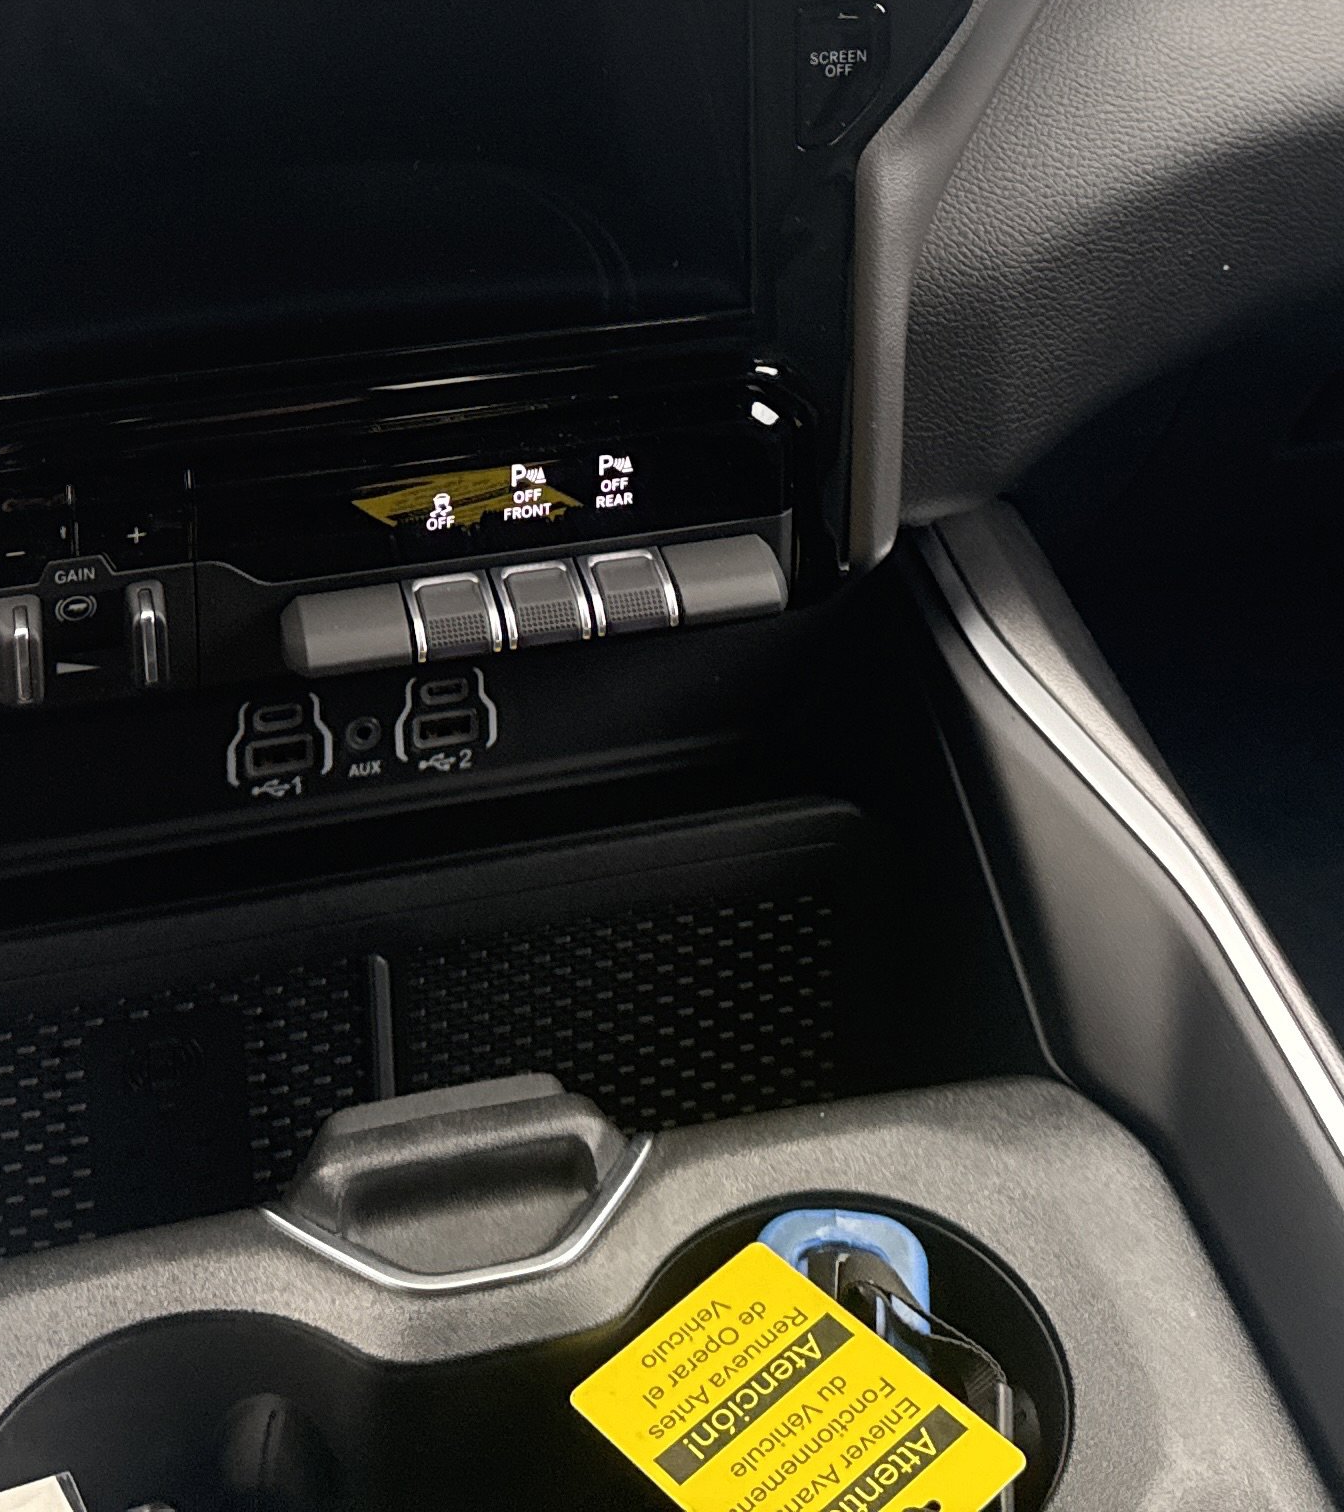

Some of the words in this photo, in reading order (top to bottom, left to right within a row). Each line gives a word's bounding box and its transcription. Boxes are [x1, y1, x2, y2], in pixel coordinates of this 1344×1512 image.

[809, 49, 867, 66] SCREEN
[825, 63, 854, 78] OFF
[600, 477, 629, 493] OFF
[513, 490, 542, 505] OFF
[596, 492, 633, 509] REAR
[426, 515, 455, 531] OFF
[504, 503, 552, 521] FRONT
[55, 567, 96, 585] GAIN
[348, 760, 383, 778] AUX
[459, 749, 473, 769] 2
[292, 776, 302, 794] 1
[738, 1301, 766, 1326] de
[641, 1300, 732, 1368] Vehículo
[668, 1326, 740, 1388] Operar
[708, 1306, 809, 1388] Remueva
[642, 1386, 665, 1409] el
[683, 1332, 822, 1460] Atención!
[817, 1376, 847, 1402] du
[648, 1385, 710, 1439] Antes
[729, 1376, 896, 1512] Fonctionnemen
[730, 1403, 823, 1477] Véhicule
[843, 1396, 921, 1469] Enlever
[829, 1427, 937, 1512] Attenti
[777, 1464, 841, 1512] Avan
